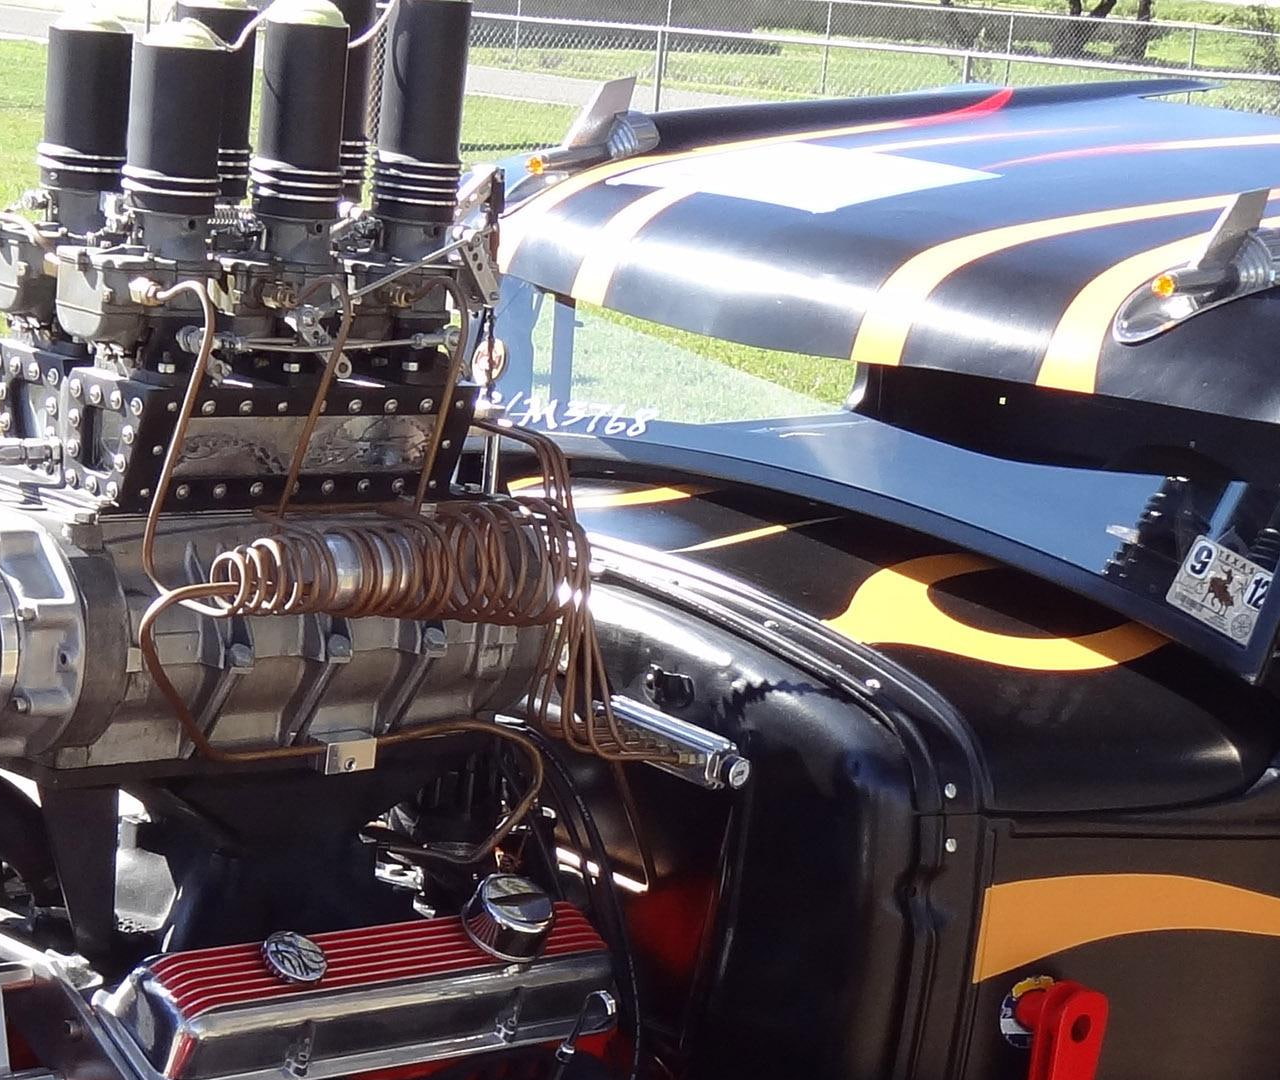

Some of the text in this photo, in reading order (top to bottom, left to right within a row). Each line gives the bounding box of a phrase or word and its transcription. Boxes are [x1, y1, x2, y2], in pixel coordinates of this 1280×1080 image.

[1190, 545, 1214, 575] 9
[1218, 549, 1255, 575] TEXAS
[1246, 577, 1270, 609] 12
